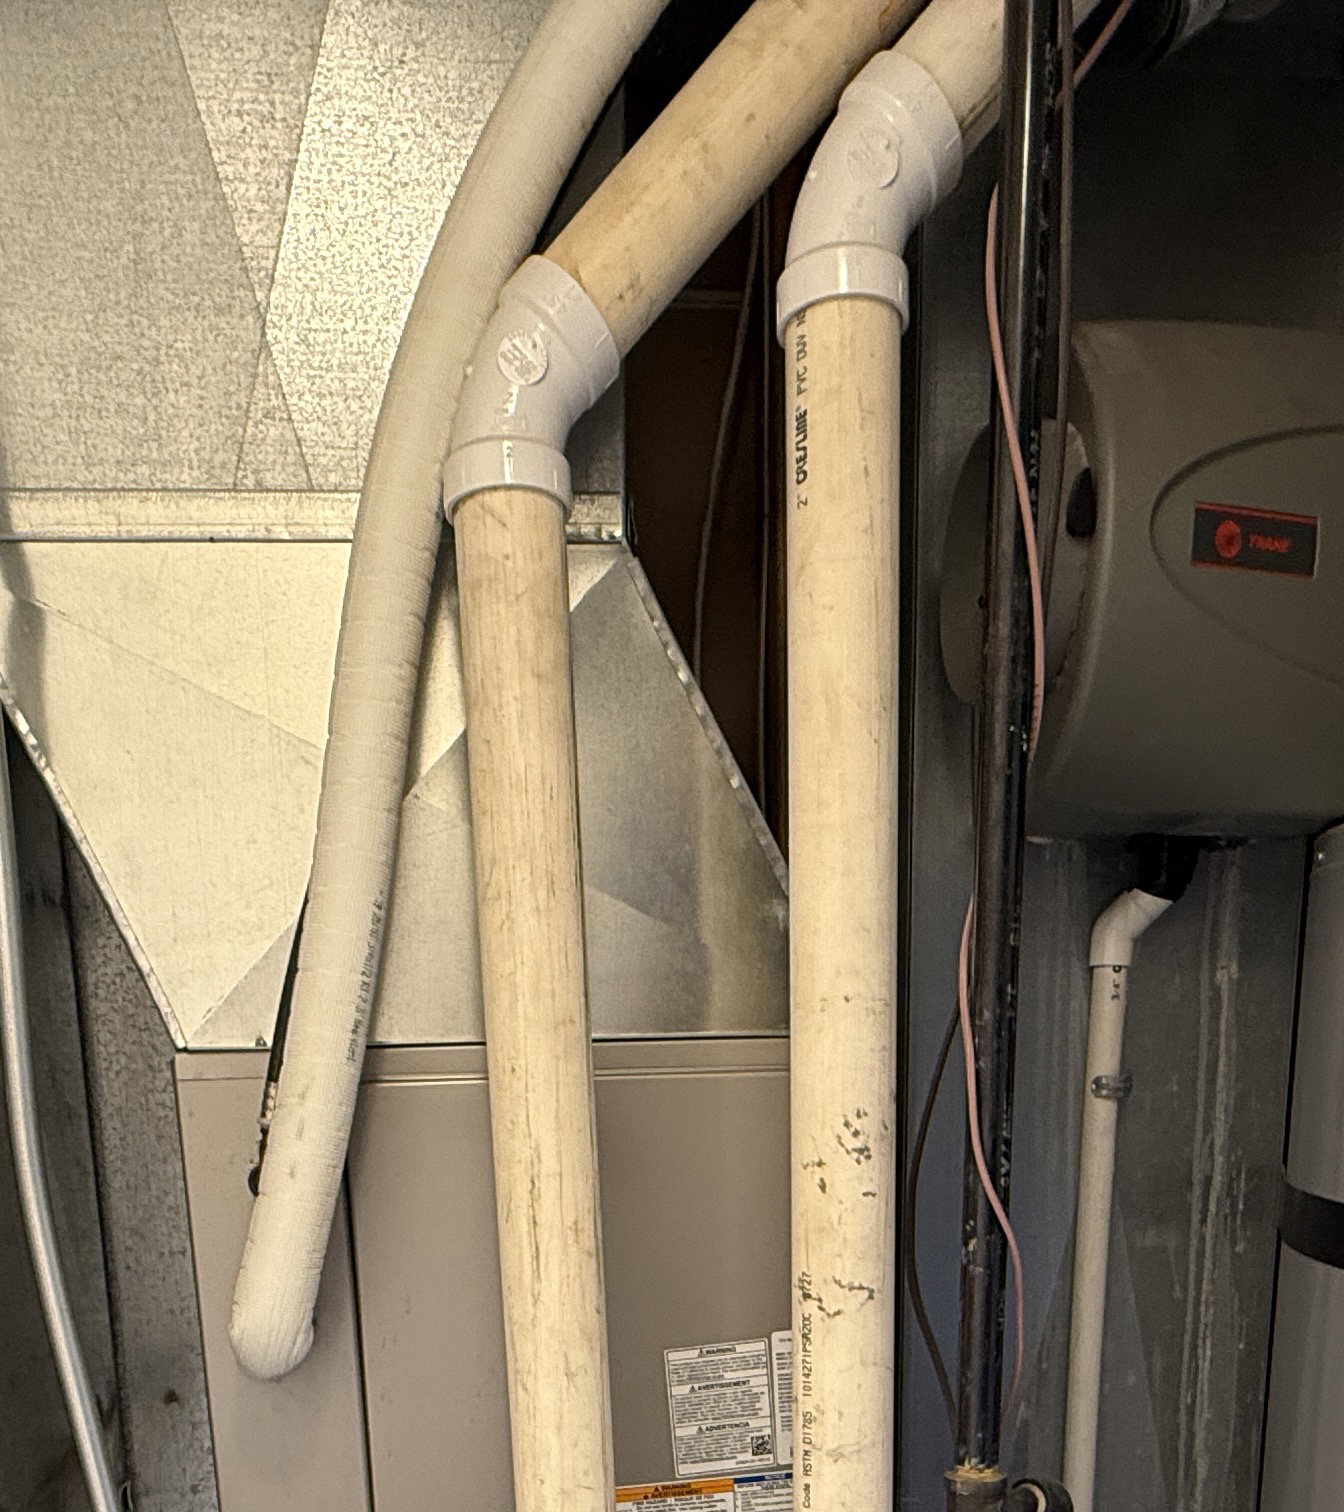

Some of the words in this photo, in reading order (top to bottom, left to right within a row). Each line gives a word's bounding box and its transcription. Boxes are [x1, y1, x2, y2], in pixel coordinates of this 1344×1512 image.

[796, 367, 807, 396] PVC
[1248, 533, 1293, 553] TRANE
[697, 1380, 750, 1391] AVERTISSEMENT
[705, 1422, 750, 1432] ADVERTENCIA
[801, 1410, 813, 1446] D1785
[801, 1449, 812, 1476] ASTM
[801, 1483, 812, 1508] Code
